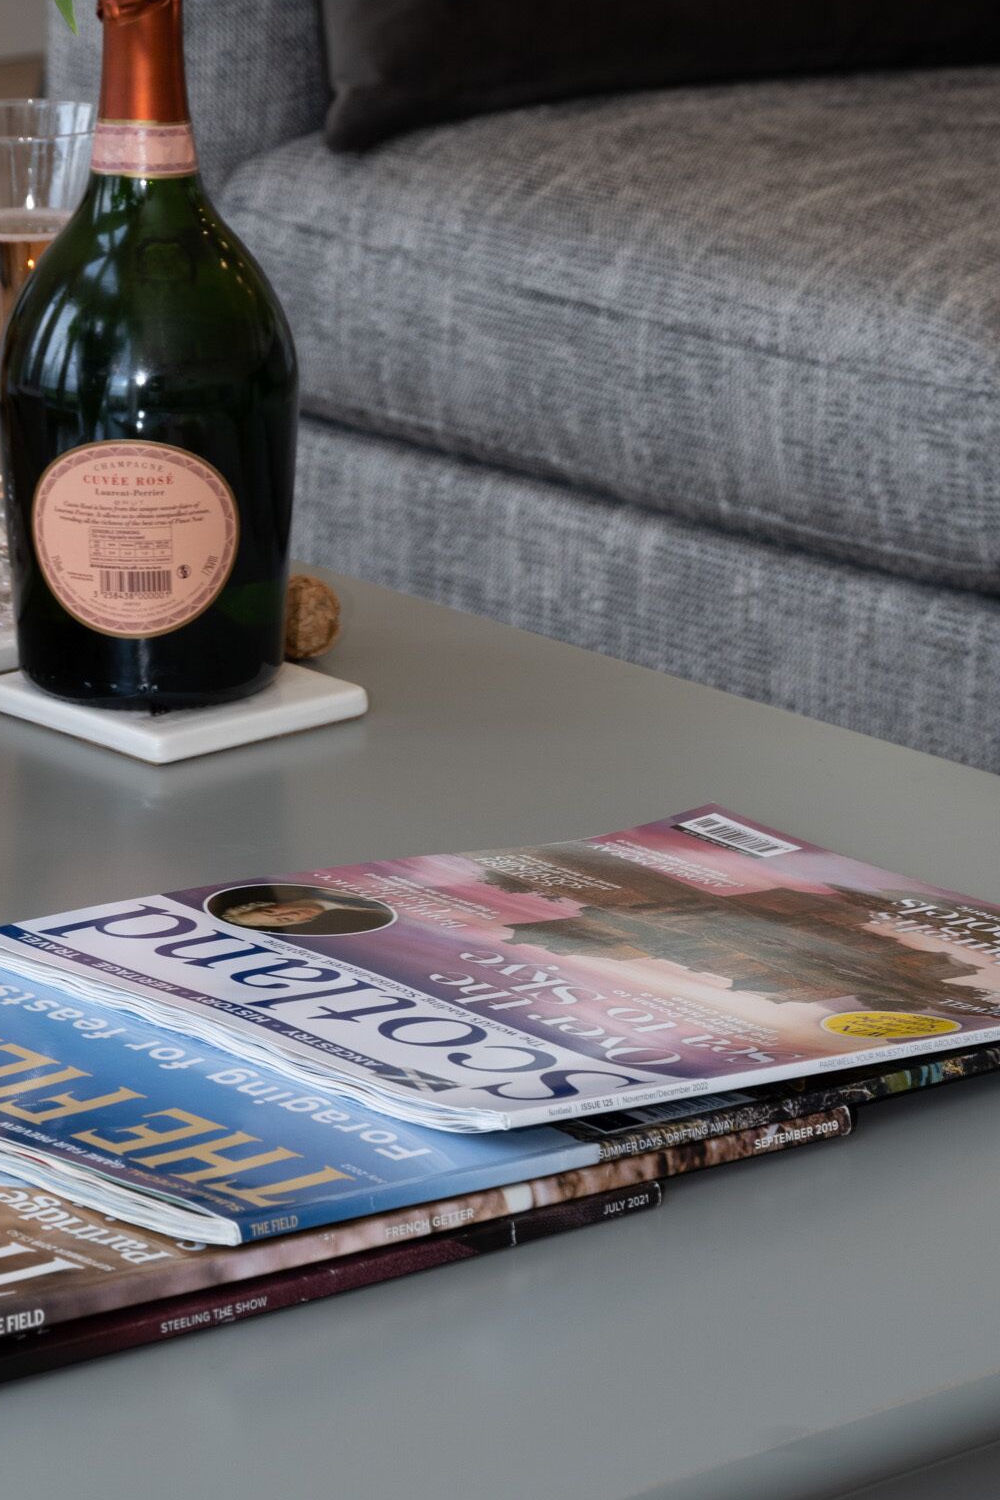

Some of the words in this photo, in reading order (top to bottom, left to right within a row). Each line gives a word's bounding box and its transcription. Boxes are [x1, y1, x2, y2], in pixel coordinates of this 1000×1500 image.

[83, 474, 129, 486] CUVÉE
[136, 473, 175, 486] ROSÉ
[93, 461, 164, 472] CHAMPAGNE
[95, 488, 165, 497] Laurent-Perrier
[17, 932, 80, 957] TRAVEL
[261, 939, 324, 959] magazine
[91, 962, 181, 990] HERITAGE
[456, 951, 606, 1004] Skye
[36, 904, 654, 1097] Scotland
[428, 973, 536, 1010] the
[188, 995, 273, 1022] HISTORY
[418, 998, 470, 1017] leading
[602, 1006, 681, 1031] to
[625, 997, 684, 1017] Donan
[280, 1029, 384, 1066] ANCESTRY
[518, 1037, 547, 1047] The
[523, 1014, 683, 1066] Over
[677, 1033, 800, 1064] Sea
[819, 1057, 855, 1069] FAREWELL
[856, 1051, 874, 1062] YOUR
[875, 1047, 905, 1059] MAJESTY
[911, 1042, 932, 1053] CRUISE
[934, 1037, 962, 1049] AROUND
[122, 1041, 205, 1068] for
[581, 1100, 601, 1111] ISSUE
[603, 1098, 614, 1107] 125
[622, 1086, 691, 1104] November/December
[692, 1082, 709, 1091] 2022
[203, 1067, 433, 1160] Foraging
[51, 1141, 89, 1153] FAIR
[599, 1142, 638, 1159] SUMMER
[668, 1124, 709, 1144] DRIFTING
[710, 1120, 735, 1134] AWAY
[754, 1125, 814, 1150] SEPTEMBER
[816, 1120, 839, 1135] 2019
[69, 1107, 356, 1207] THE
[80, 1152, 128, 1168] GAME
[603, 1200, 626, 1215] JULY
[628, 1194, 650, 1208] 2021
[250, 1220, 270, 1236] THE
[271, 1215, 298, 1232] FIELD
[385, 1218, 430, 1238] FRENCH
[432, 1208, 475, 1227] GETTER
[53, 1248, 116, 1271] SEPTEMBER
[6, 1309, 45, 1333] FIELD
[161, 1311, 211, 1334] STEELING
[212, 1304, 233, 1320] THE
[235, 1296, 268, 1314] SHOW
